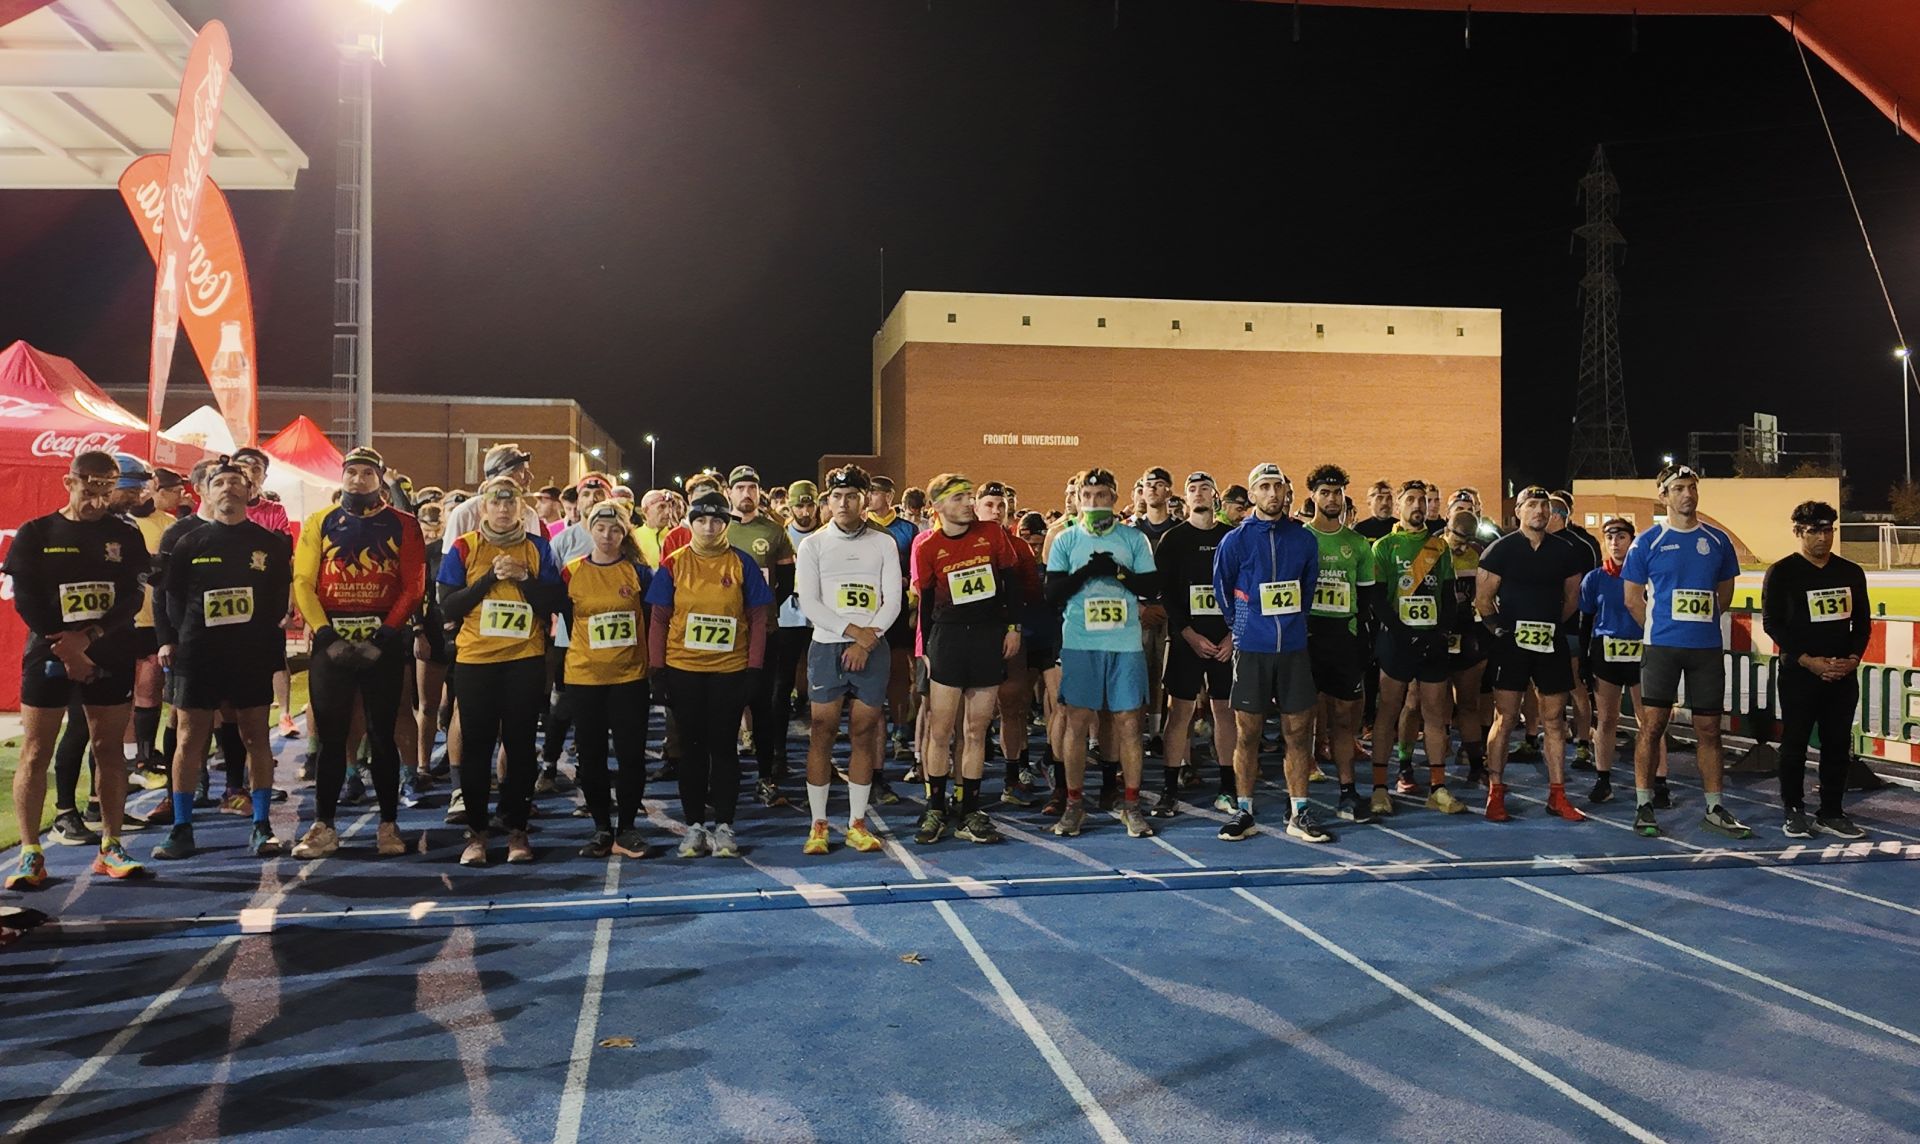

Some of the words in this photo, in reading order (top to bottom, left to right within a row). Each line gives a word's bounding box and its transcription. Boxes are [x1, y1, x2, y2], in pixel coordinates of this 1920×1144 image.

[31, 430, 126, 458] Coca-Cola
[983, 432, 1019, 445] FRONTÓN
[1021, 434, 1079, 446] UNIVERSITARIO
[1319, 569, 1347, 578] SMART
[962, 577, 985, 595] 44
[67, 593, 110, 613] 208
[846, 591, 870, 607] 59
[1271, 591, 1294, 608] 42
[1314, 589, 1345, 606] 111
[1814, 597, 1849, 615] 131
[209, 598, 249, 618] 210
[1089, 607, 1123, 622] 253
[1408, 605, 1430, 619] 68
[1676, 598, 1711, 615] 204
[488, 611, 526, 631] 174
[594, 621, 632, 641] 173
[692, 625, 730, 644] 172
[1519, 629, 1550, 646] 232
[1608, 641, 1640, 657] 127
